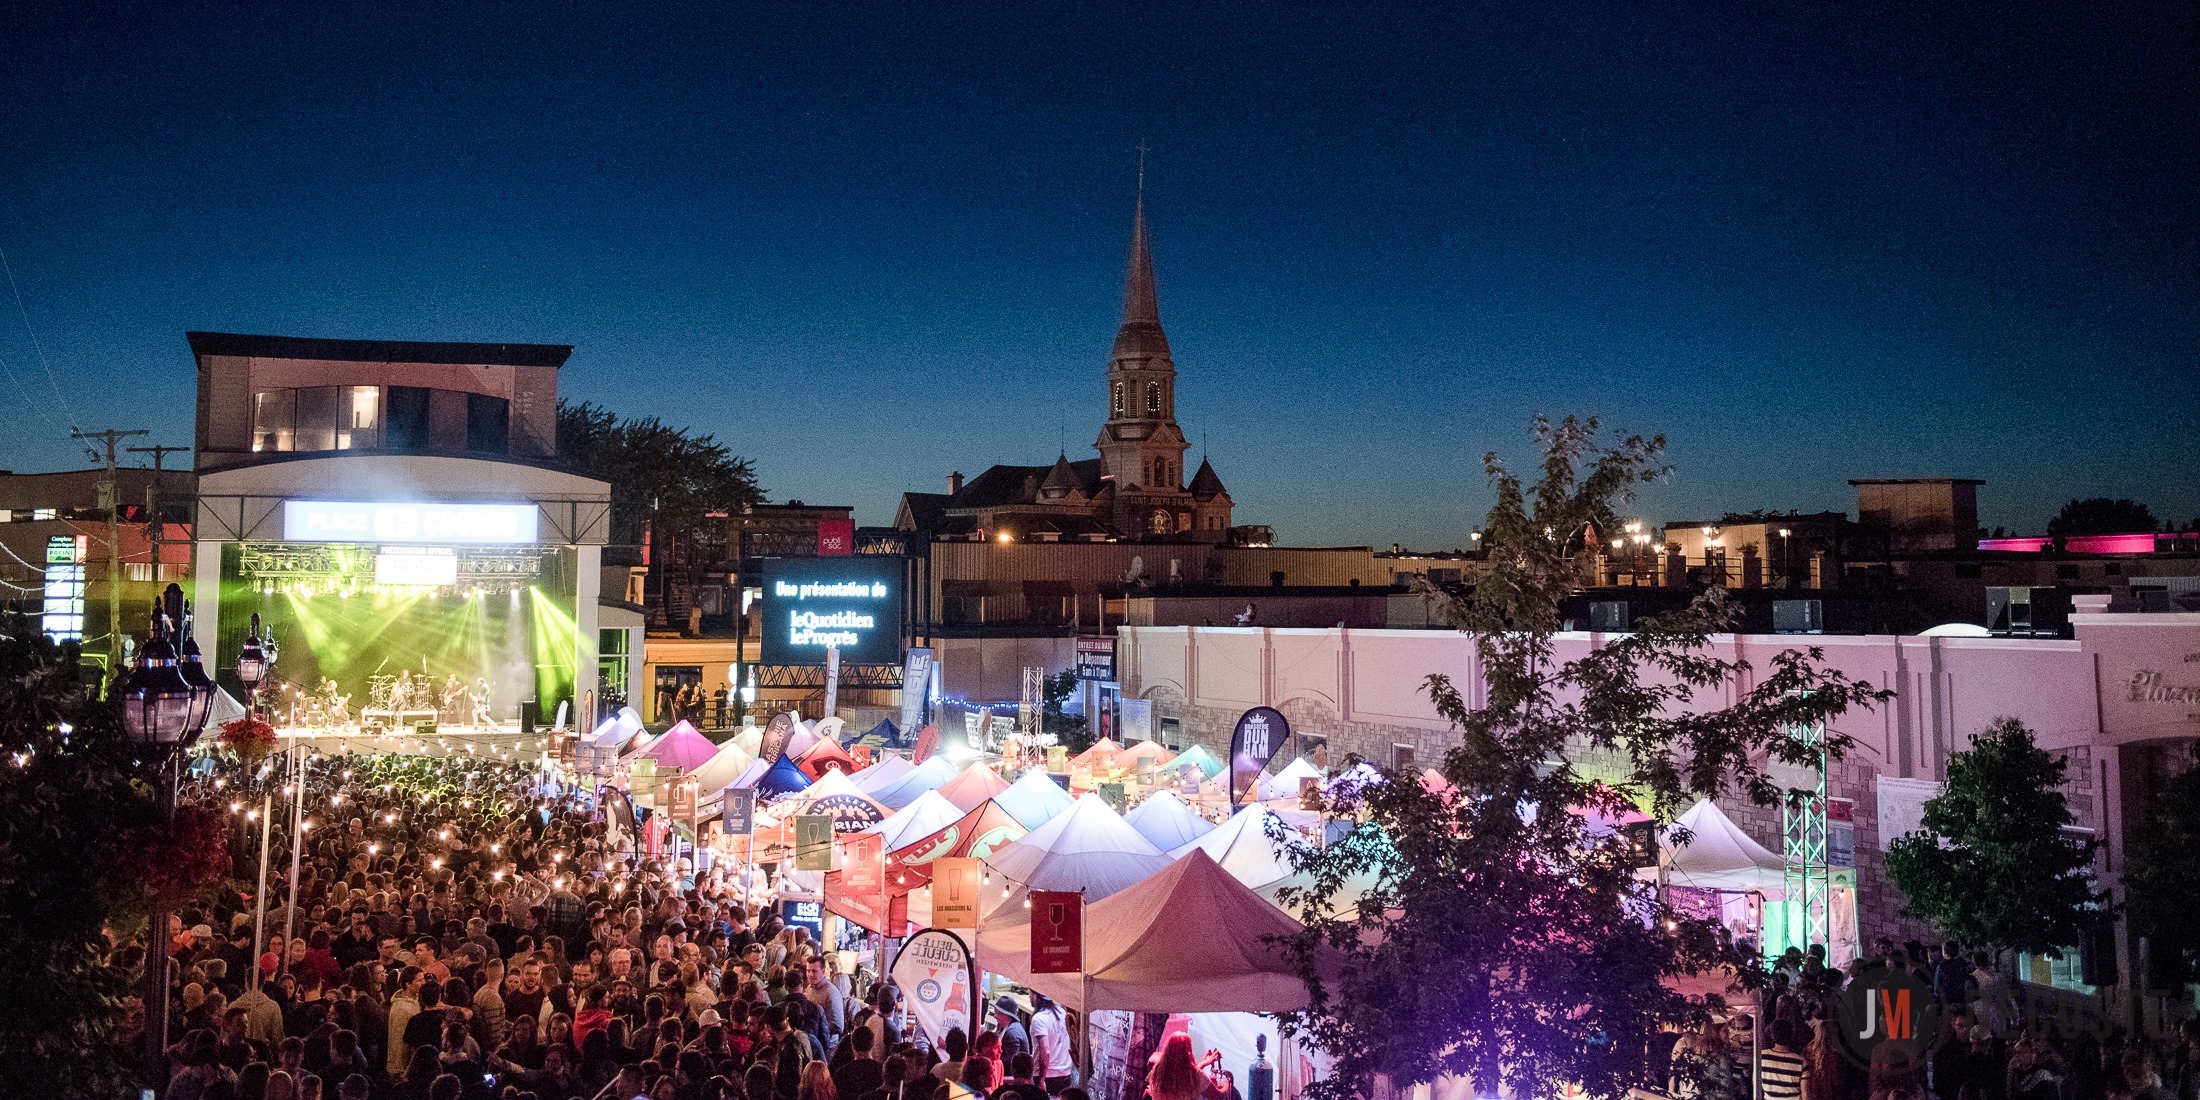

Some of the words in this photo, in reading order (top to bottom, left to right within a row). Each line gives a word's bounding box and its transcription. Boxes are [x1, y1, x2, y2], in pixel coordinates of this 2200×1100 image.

[307, 512, 368, 530] PLACE
[823, 537, 841, 545] publi
[828, 542, 842, 550] sac
[776, 581, 798, 596] Une
[800, 581, 869, 600] présentation
[872, 582, 887, 597] de
[790, 610, 874, 629] leQuotidien
[790, 628, 858, 649] leProgrès
[1078, 641, 1093, 649] ENTRÉE
[1101, 642, 1112, 650] MAIL
[899, 654, 926, 742] NERGIE
[765, 720, 784, 764] ASSERIE
[770, 724, 789, 765] RRICANA
[1244, 729, 1269, 744] DUN
[1243, 743, 1269, 759] HAM
[834, 820, 882, 830] RIAN
